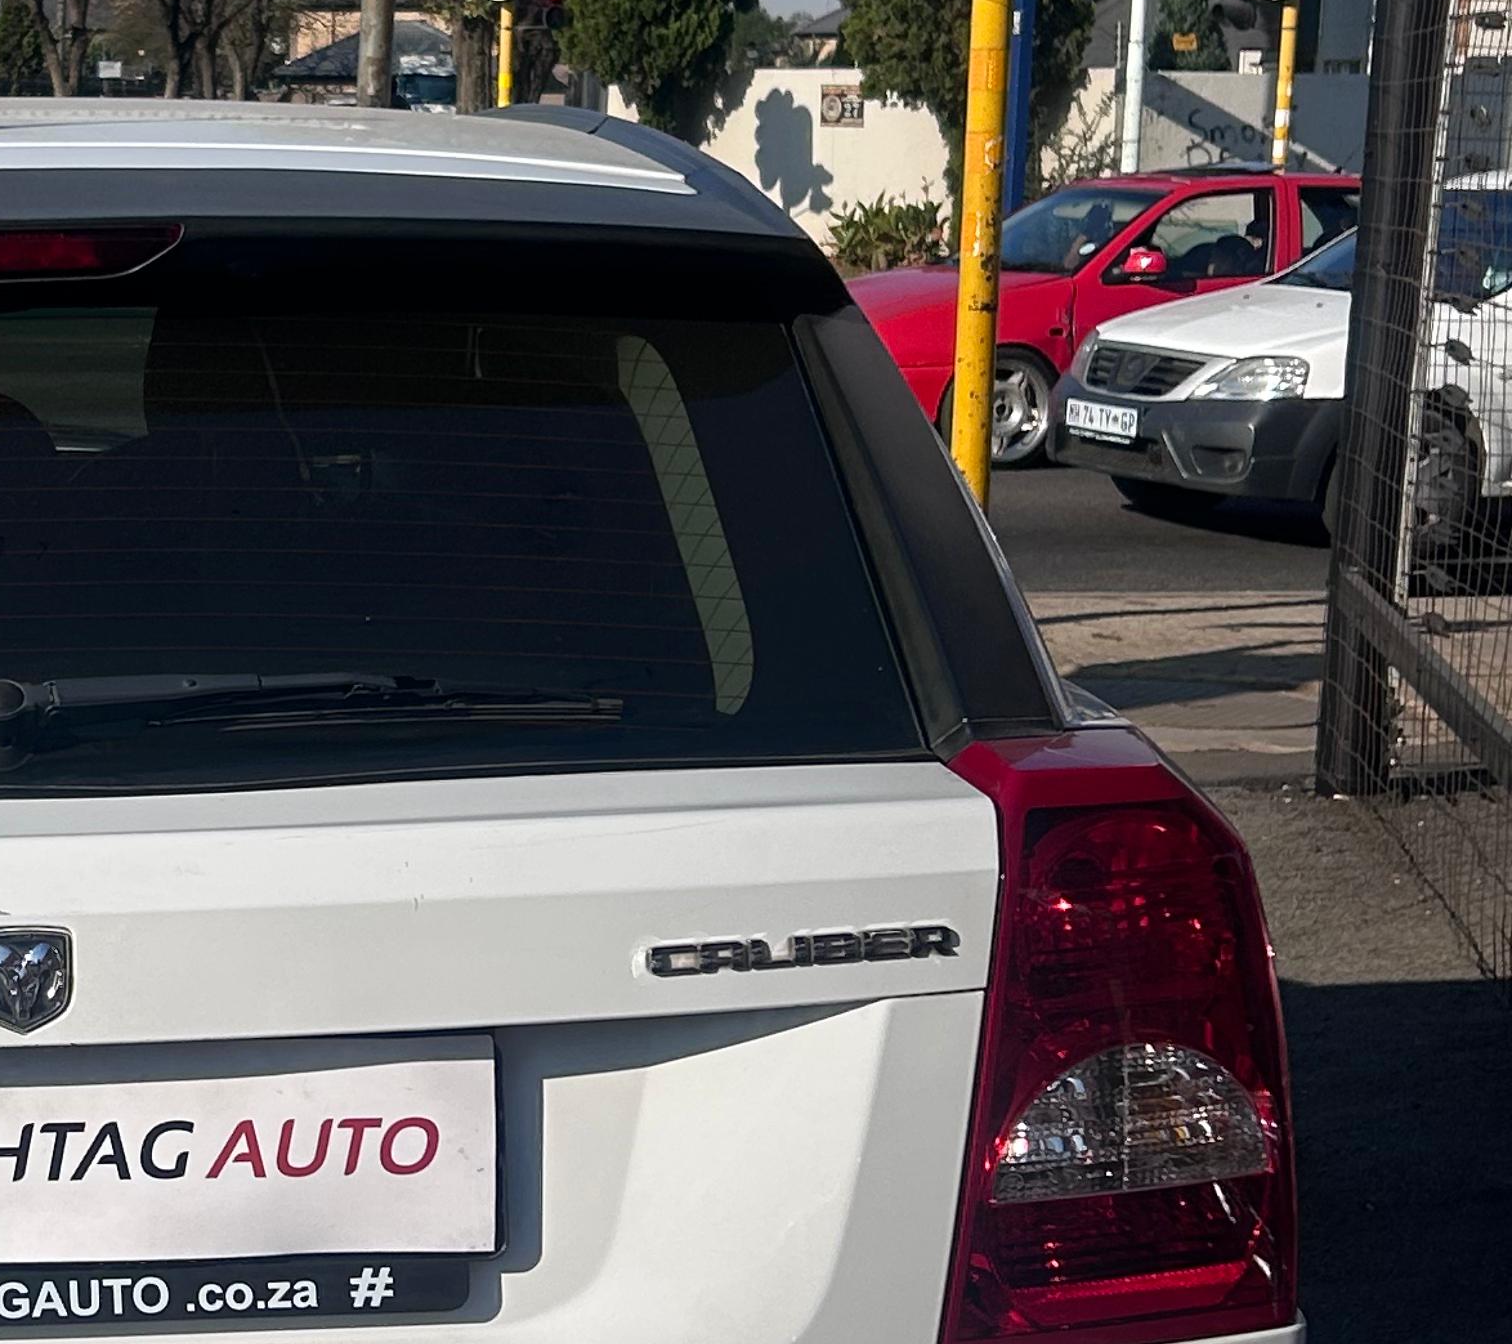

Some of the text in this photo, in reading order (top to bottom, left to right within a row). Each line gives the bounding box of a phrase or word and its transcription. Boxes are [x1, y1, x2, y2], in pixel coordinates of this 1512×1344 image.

[1120, 412, 1136, 433] GP
[645, 922, 961, 979] CALIBER
[205, 1116, 440, 1179] AUTO
[186, 1279, 319, 1313] .co.za
